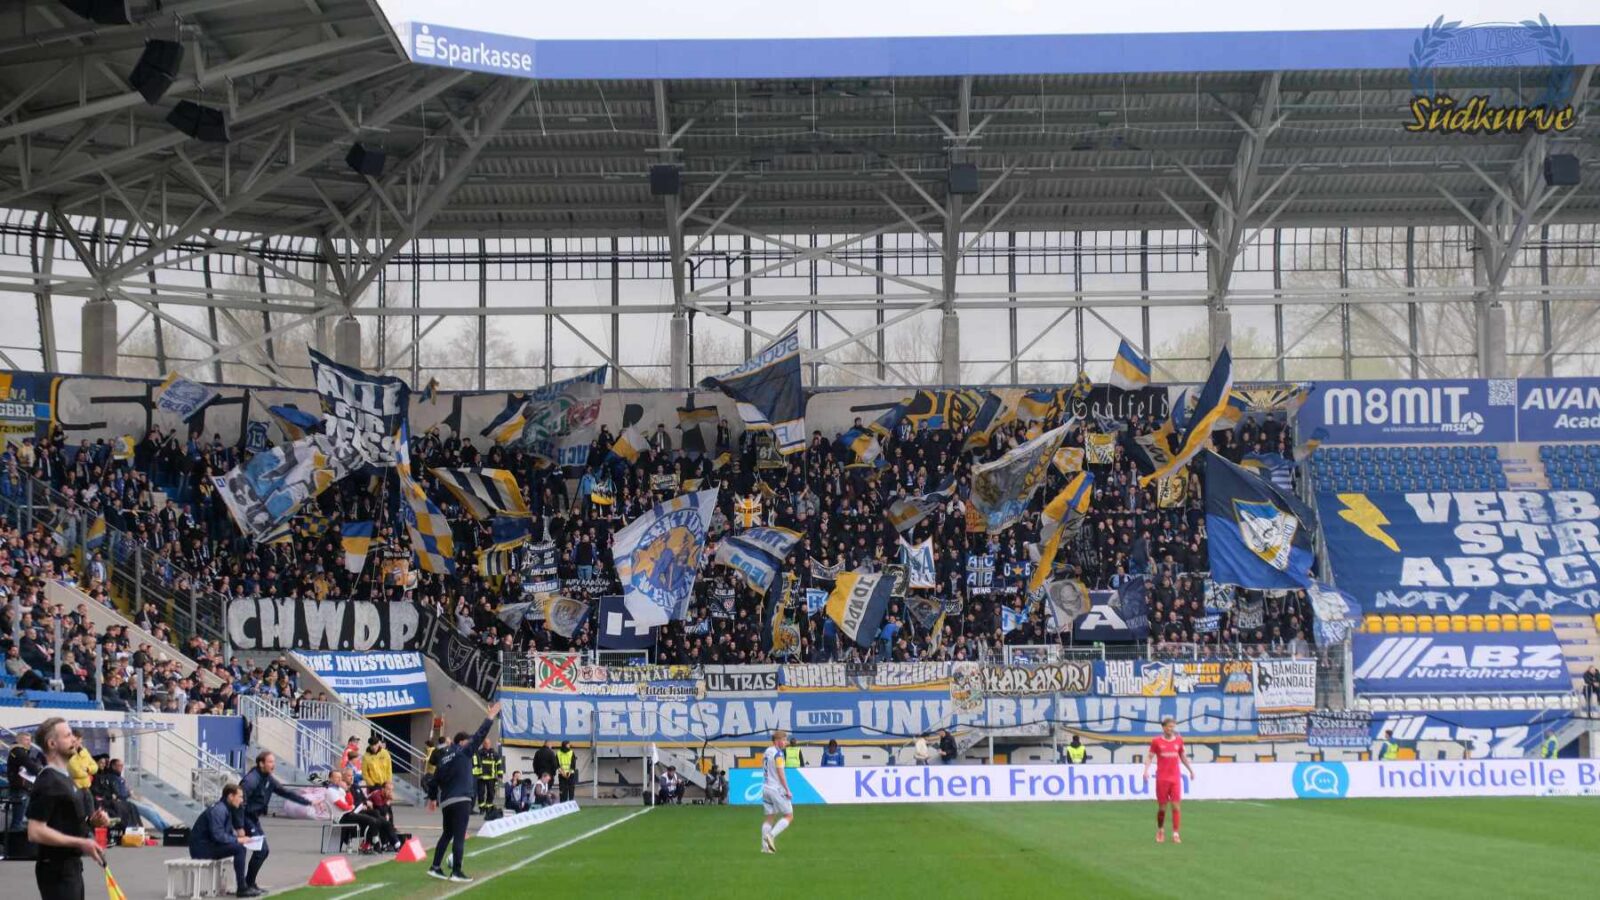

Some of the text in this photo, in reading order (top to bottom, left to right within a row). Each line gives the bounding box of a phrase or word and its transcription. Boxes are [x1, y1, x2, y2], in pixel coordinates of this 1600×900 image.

[436, 37, 532, 71] Sparkasse
[1072, 394, 1169, 420] Saalfeld
[1400, 553, 1600, 588] ABSC
[335, 653, 422, 672] INVESTOREN
[1416, 645, 1562, 667] ABZ
[708, 672, 776, 691] ULTRAS
[1272, 664, 1315, 675] BAMBULE
[1408, 666, 1562, 681] Nutzfahrzeuge
[1273, 676, 1315, 688] RANDALE
[501, 698, 793, 738] UNBEUGSAM
[808, 711, 843, 724] UND
[854, 769, 991, 798] Küchen
[1379, 763, 1600, 790] Individuelle B
